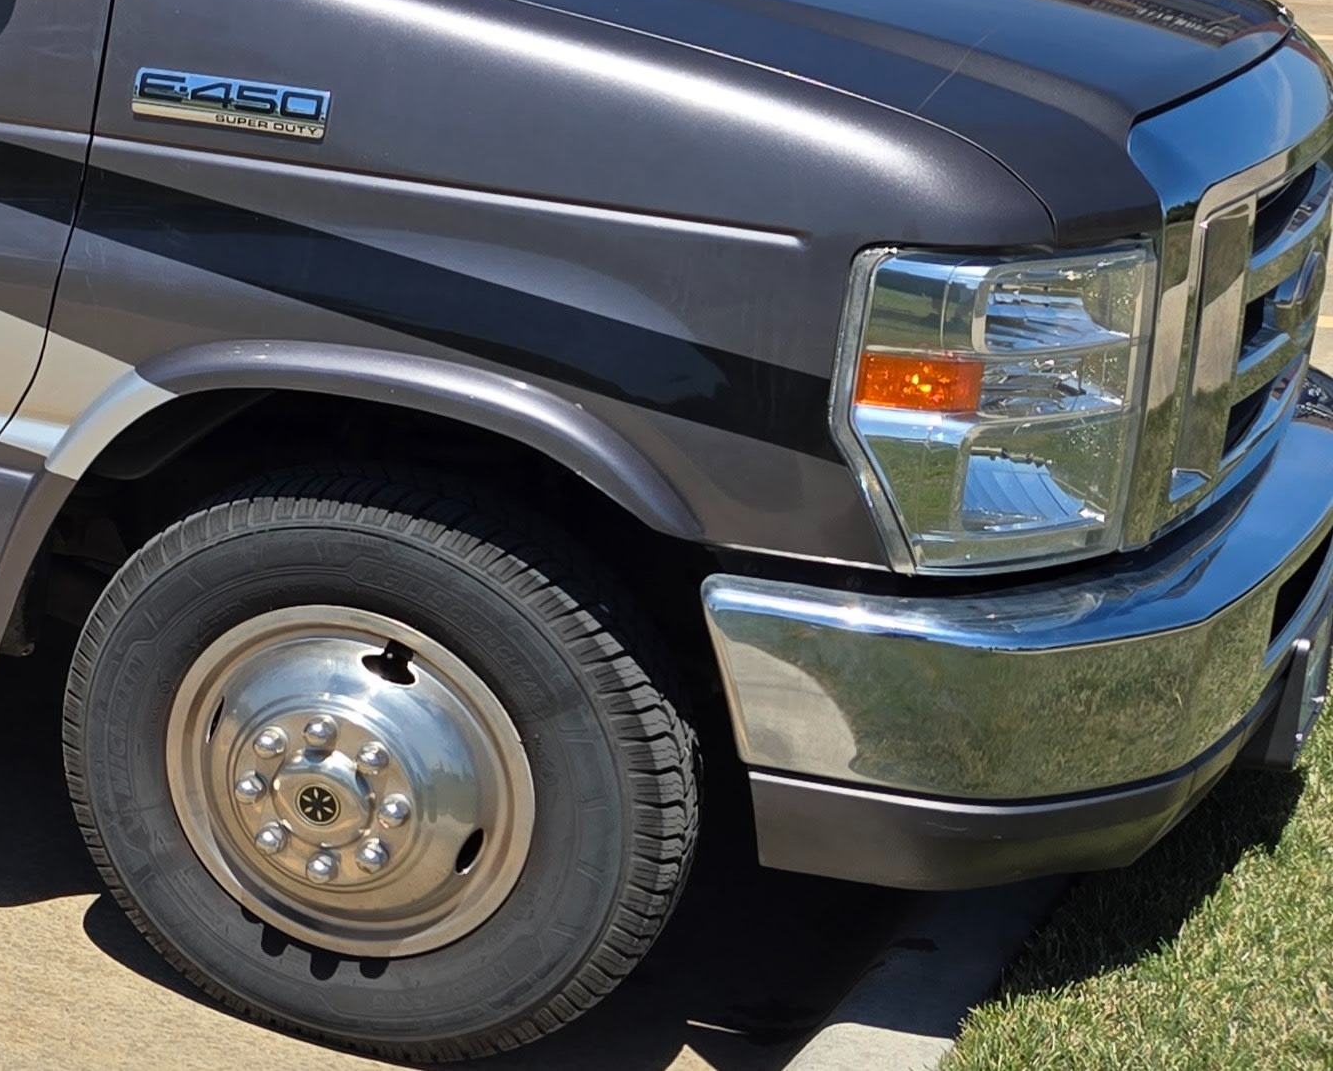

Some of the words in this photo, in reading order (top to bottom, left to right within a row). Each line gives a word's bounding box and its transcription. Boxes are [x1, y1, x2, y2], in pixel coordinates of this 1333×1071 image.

[139, 72, 324, 121] E-450
[214, 113, 269, 130] SUPER
[273, 122, 318, 136] DUTY
